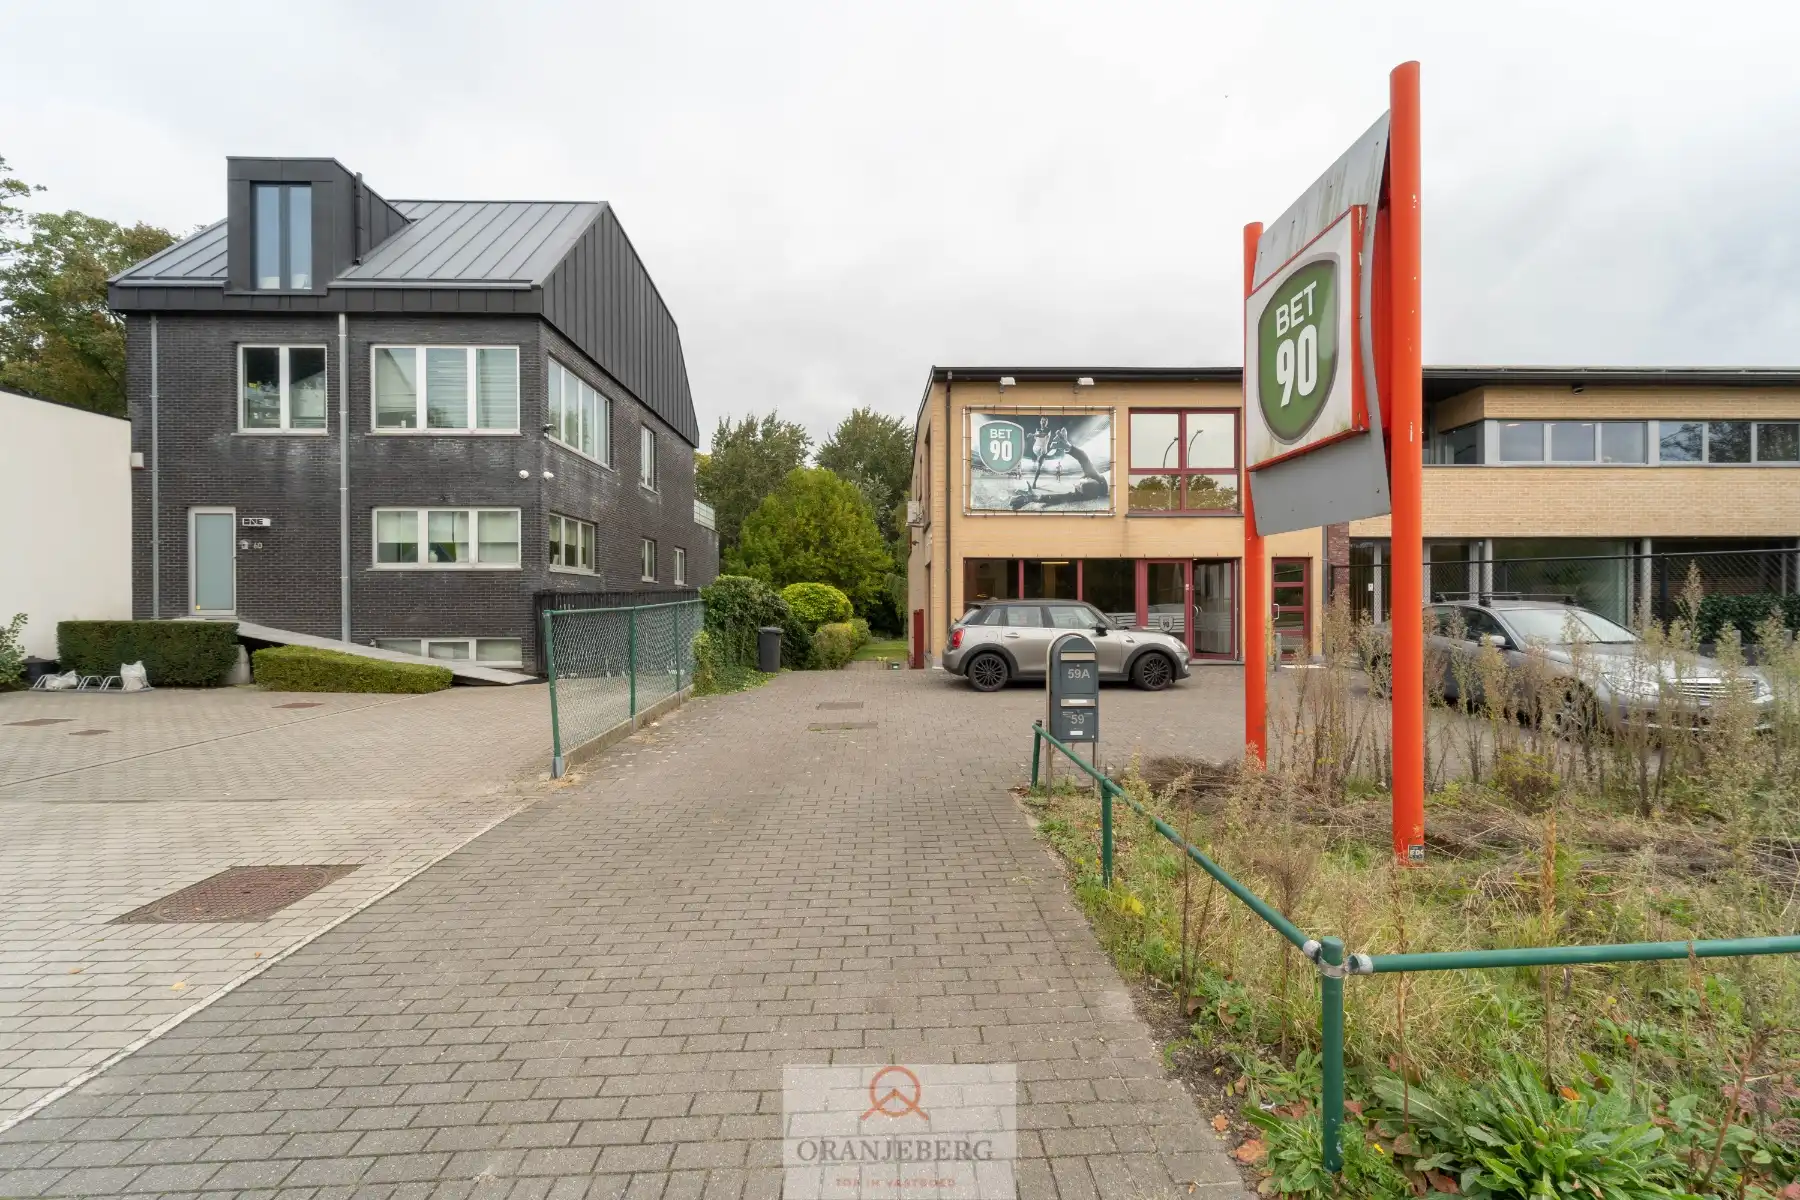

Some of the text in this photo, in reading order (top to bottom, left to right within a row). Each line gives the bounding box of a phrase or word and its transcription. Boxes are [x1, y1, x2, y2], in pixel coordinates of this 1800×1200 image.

[1275, 280, 1317, 338] BET
[1276, 324, 1318, 408] 90
[989, 428, 1012, 439] BET
[989, 440, 1013, 461] 90
[1067, 668, 1090, 679] 59A
[1071, 714, 1085, 724] 59
